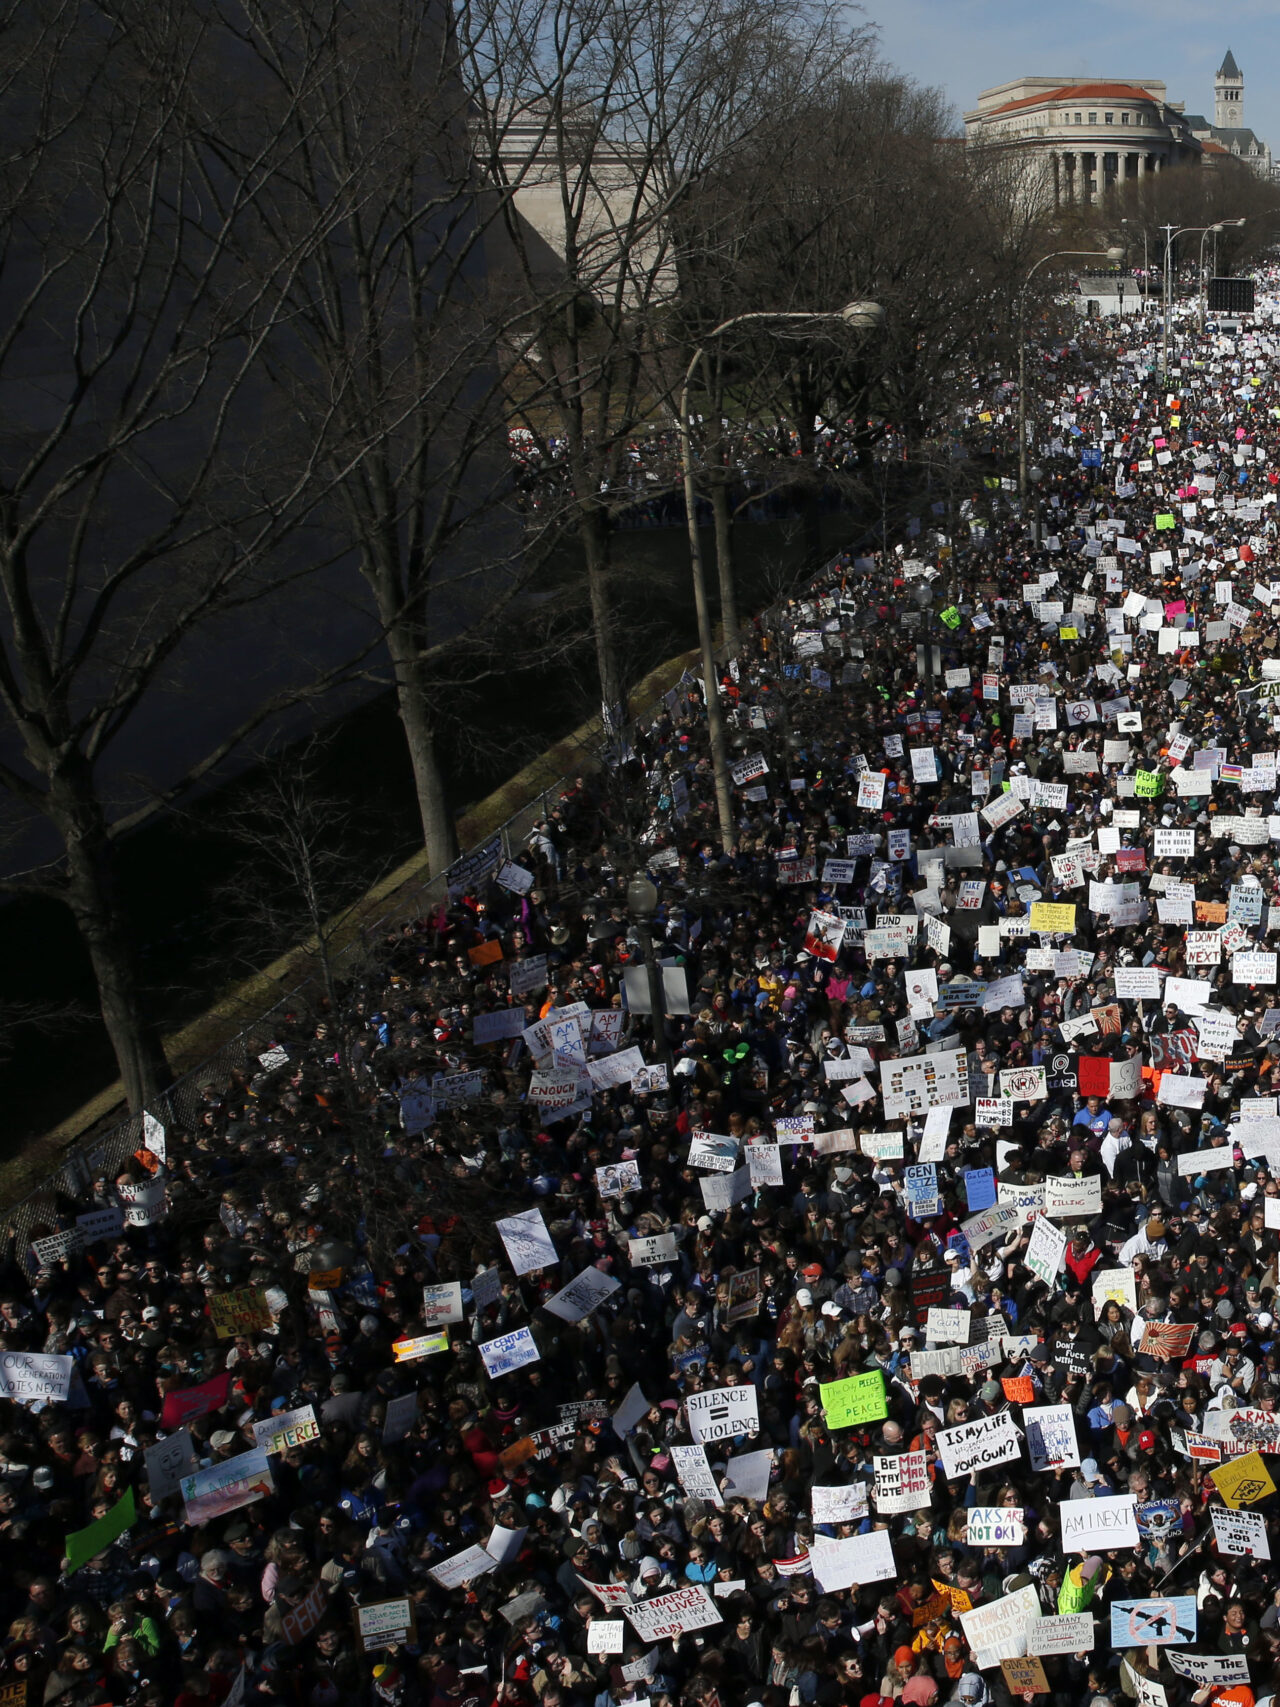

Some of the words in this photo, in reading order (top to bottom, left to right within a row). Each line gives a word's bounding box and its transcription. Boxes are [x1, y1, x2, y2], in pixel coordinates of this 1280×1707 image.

[1058, 861, 1076, 873] KIDS
[1235, 886, 1259, 894] REJECT
[877, 917, 901, 925] FUND
[1189, 952, 1220, 962] NEXT
[556, 1022, 574, 1034] AM
[531, 1083, 575, 1095] ENOUGH
[908, 1166, 932, 1178] GEN
[1012, 1196, 1043, 1207] BOOKS
[641, 1254, 666, 1263] NEXT?
[493, 1328, 529, 1348] CENTURY
[979, 1349, 995, 1360] NOT
[1055, 1356, 1073, 1364] WITH
[1066, 1350, 1085, 1359] FUCK
[4, 1355, 33, 1369] OUR
[911, 1351, 961, 1374] ENOUGH
[966, 1361, 988, 1374] GUNS
[19, 1371, 66, 1380] GENERATION
[1069, 1365, 1087, 1374] KIDS
[36, 1384, 63, 1393] NEXT
[690, 1390, 747, 1410] SILENCE
[846, 1402, 881, 1416] PEACE
[1048, 1413, 1069, 1423] BLACK
[1229, 1411, 1277, 1424] ARMS
[699, 1417, 759, 1440] VIOLENCE
[273, 1422, 318, 1450] FIERCE
[946, 1432, 963, 1446] IS
[955, 1455, 980, 1473] YOUR
[1162, 1498, 1178, 1506] KIDS
[971, 1509, 1002, 1523] AKS
[1005, 1510, 1024, 1522] ARE
[1248, 1512, 1261, 1520] IN
[1066, 1516, 1083, 1533] AM
[1089, 1516, 1092, 1528] I
[969, 1526, 991, 1540] NOT
[995, 1526, 1015, 1541] OK!
[1227, 1532, 1250, 1542] JOB
[1228, 1544, 1253, 1554] GUN
[624, 1603, 648, 1615] WE
[649, 1588, 701, 1609] MARCH
[667, 1596, 706, 1613] LIVES
[282, 1579, 328, 1645] PEACE
[1036, 1619, 1056, 1627] HOW
[1059, 1616, 1081, 1624] MANY
[1003, 1660, 1024, 1670] GIVE
[1026, 1660, 1039, 1668] ME
[1171, 1653, 1208, 1669] STOP
[1215, 1659, 1244, 1669] THE
[1012, 1671, 1035, 1679] BOOKS
[1176, 1665, 1250, 1683] VIOLENCE
